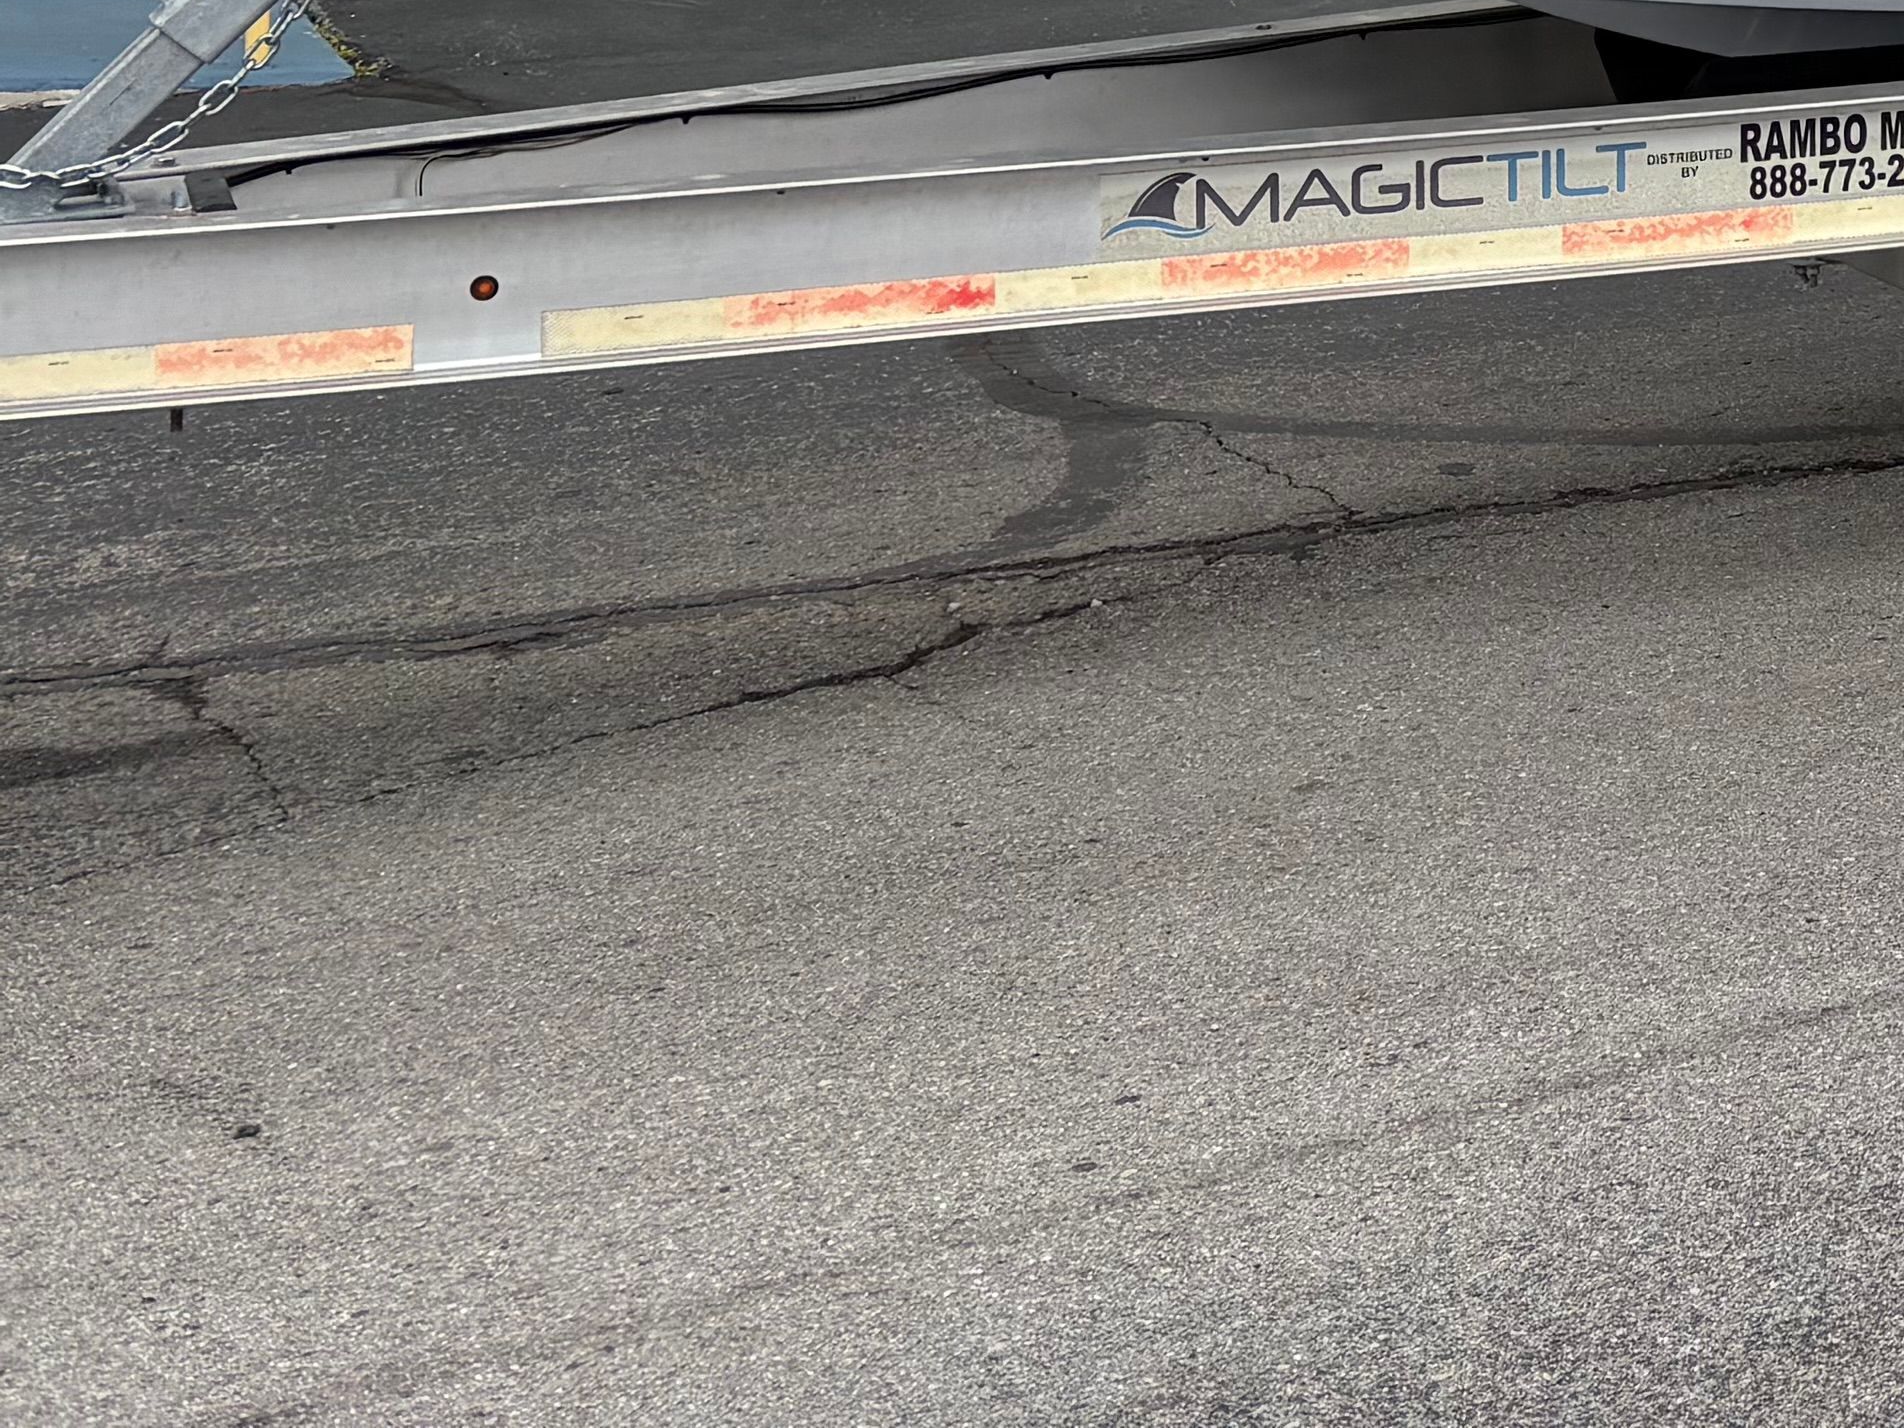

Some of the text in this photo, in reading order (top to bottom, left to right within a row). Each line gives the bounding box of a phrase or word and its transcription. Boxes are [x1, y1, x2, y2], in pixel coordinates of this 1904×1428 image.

[1739, 113, 1868, 163] RAMBO
[1647, 148, 1733, 165] DISTRIBUTED
[1681, 166, 1699, 178] BY
